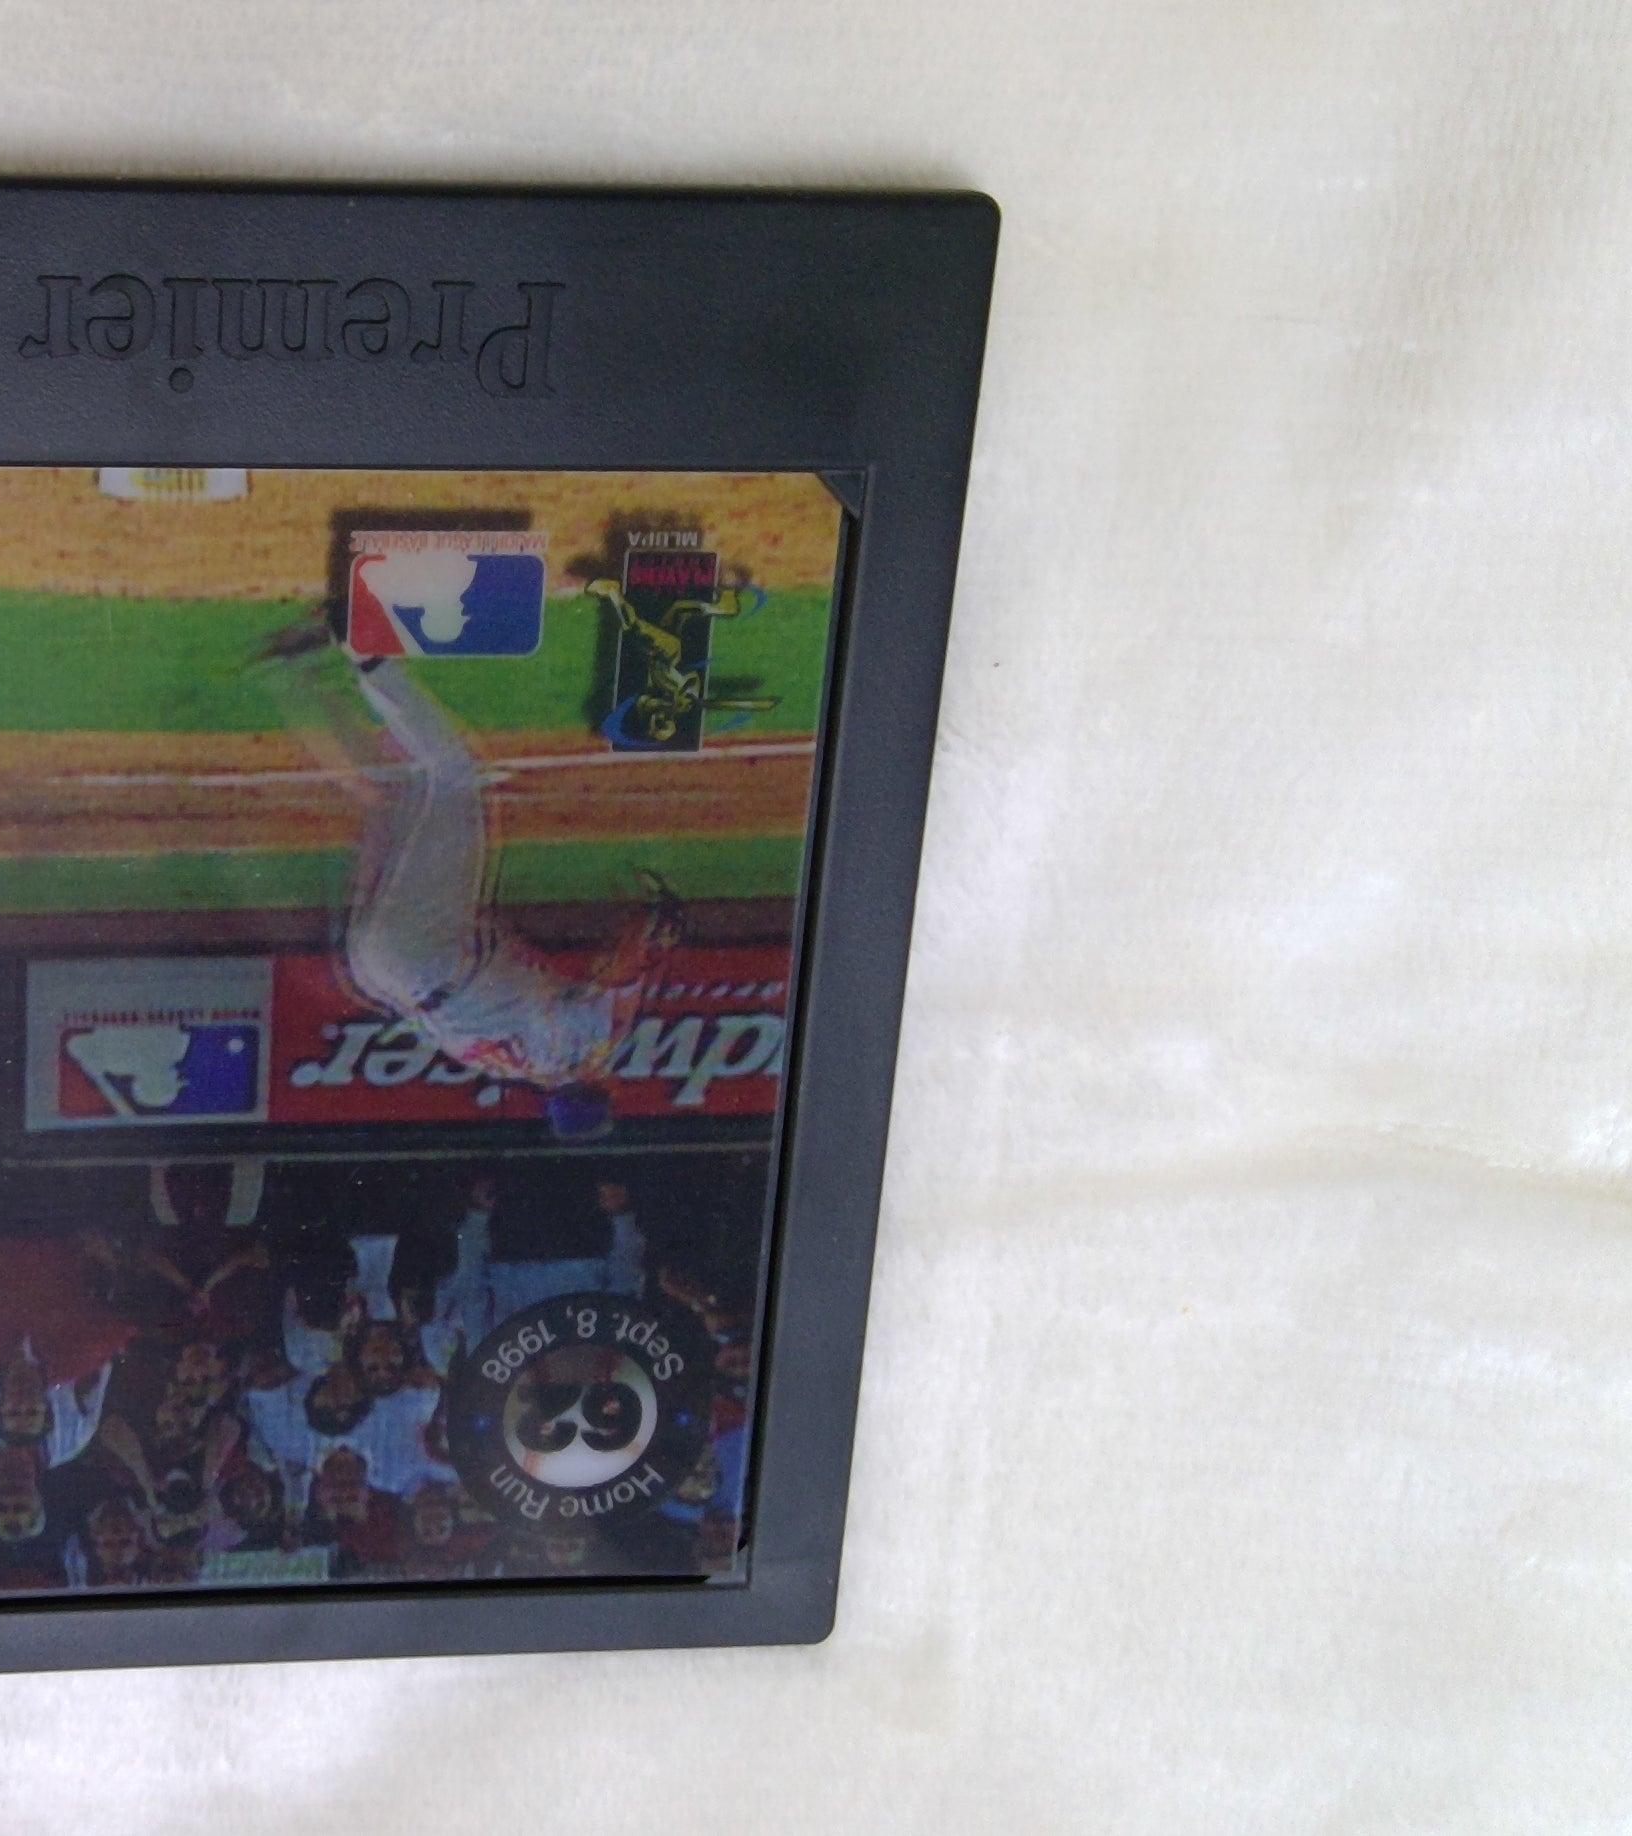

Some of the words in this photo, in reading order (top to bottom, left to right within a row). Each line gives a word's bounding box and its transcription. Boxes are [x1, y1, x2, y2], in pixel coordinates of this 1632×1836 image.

[16, 273, 566, 396] Premier
[481, 1319, 558, 1383] 1998
[565, 1305, 598, 1339] 8,
[612, 1312, 685, 1381] Sept.
[489, 1464, 550, 1520] Run
[558, 1462, 664, 1518] Home
